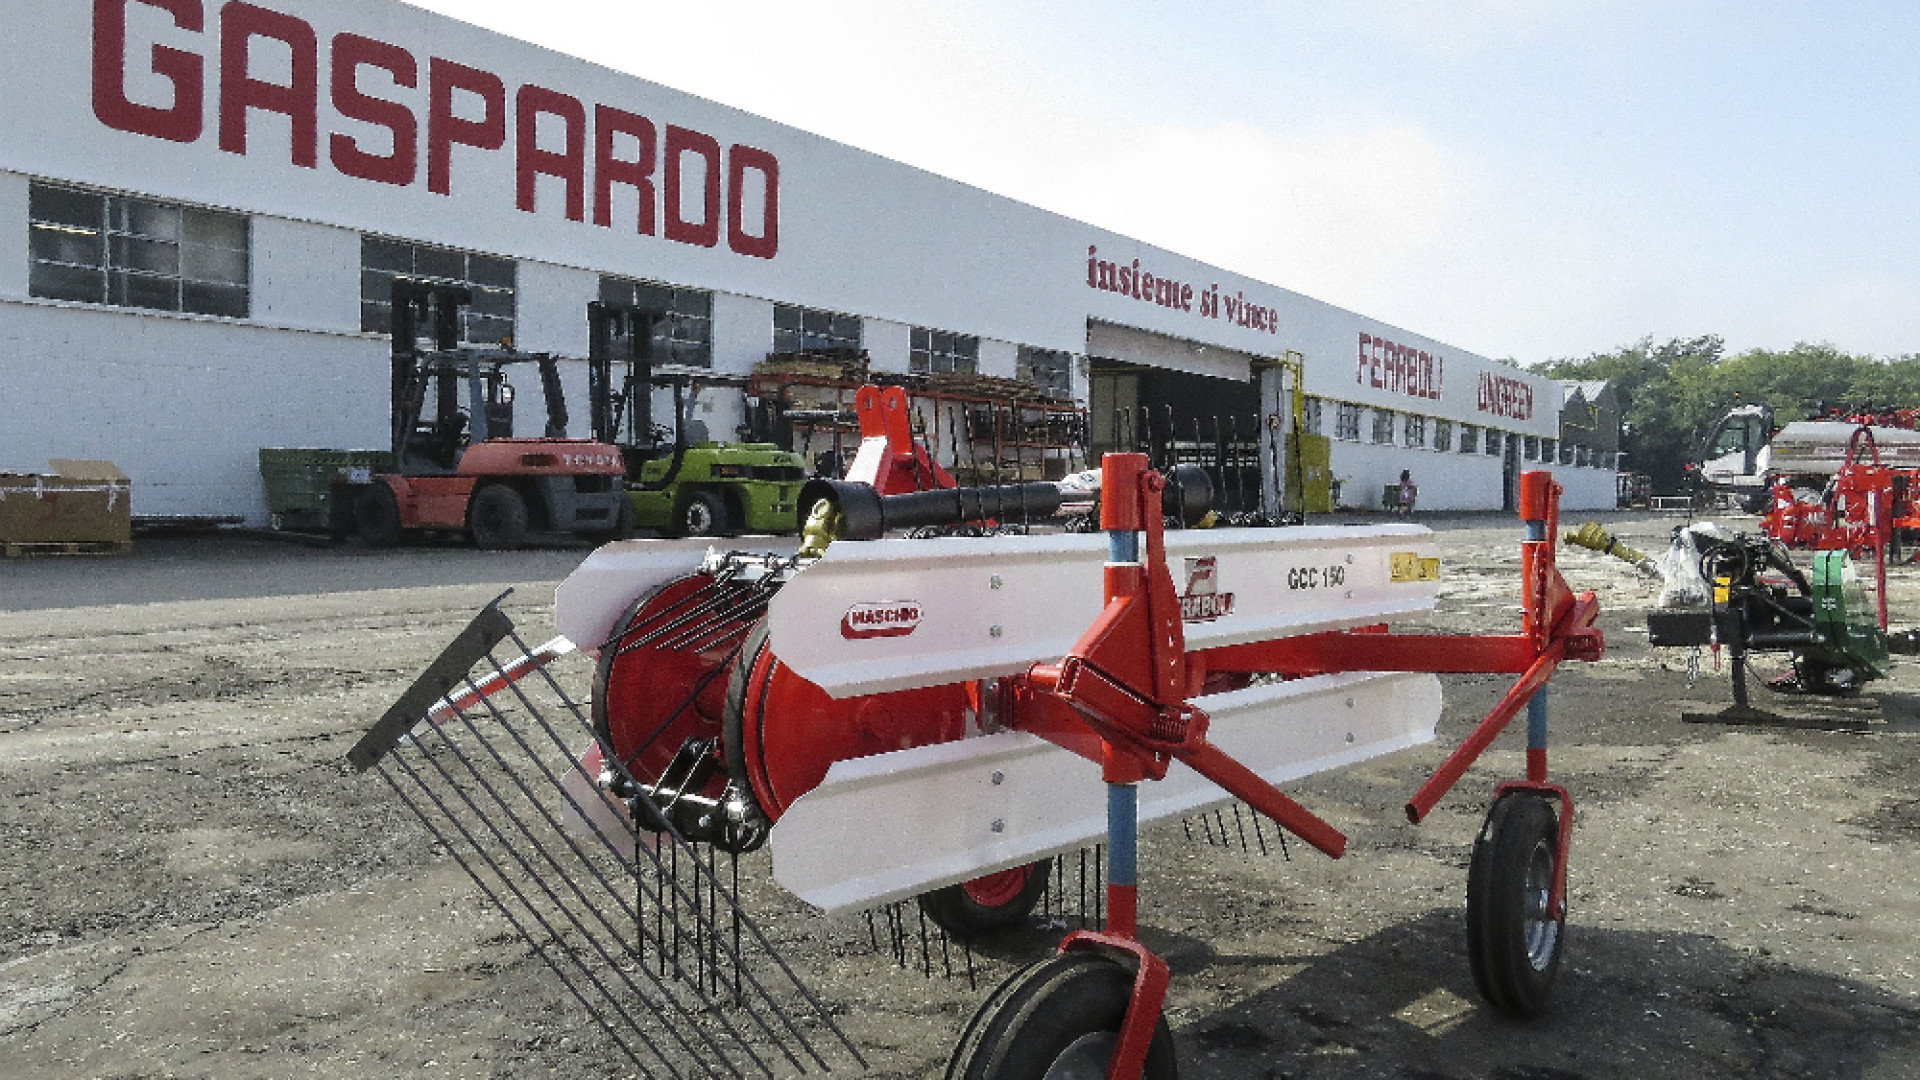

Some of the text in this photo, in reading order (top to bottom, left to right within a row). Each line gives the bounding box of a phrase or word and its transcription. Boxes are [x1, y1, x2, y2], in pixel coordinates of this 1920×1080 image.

[91, 0, 779, 260] GASPARDO
[1086, 244, 1278, 335] insieme si vince
[562, 453, 623, 468] TOYOTA
[1287, 566, 1318, 590] GCC
[851, 607, 919, 624] MASCHIO
